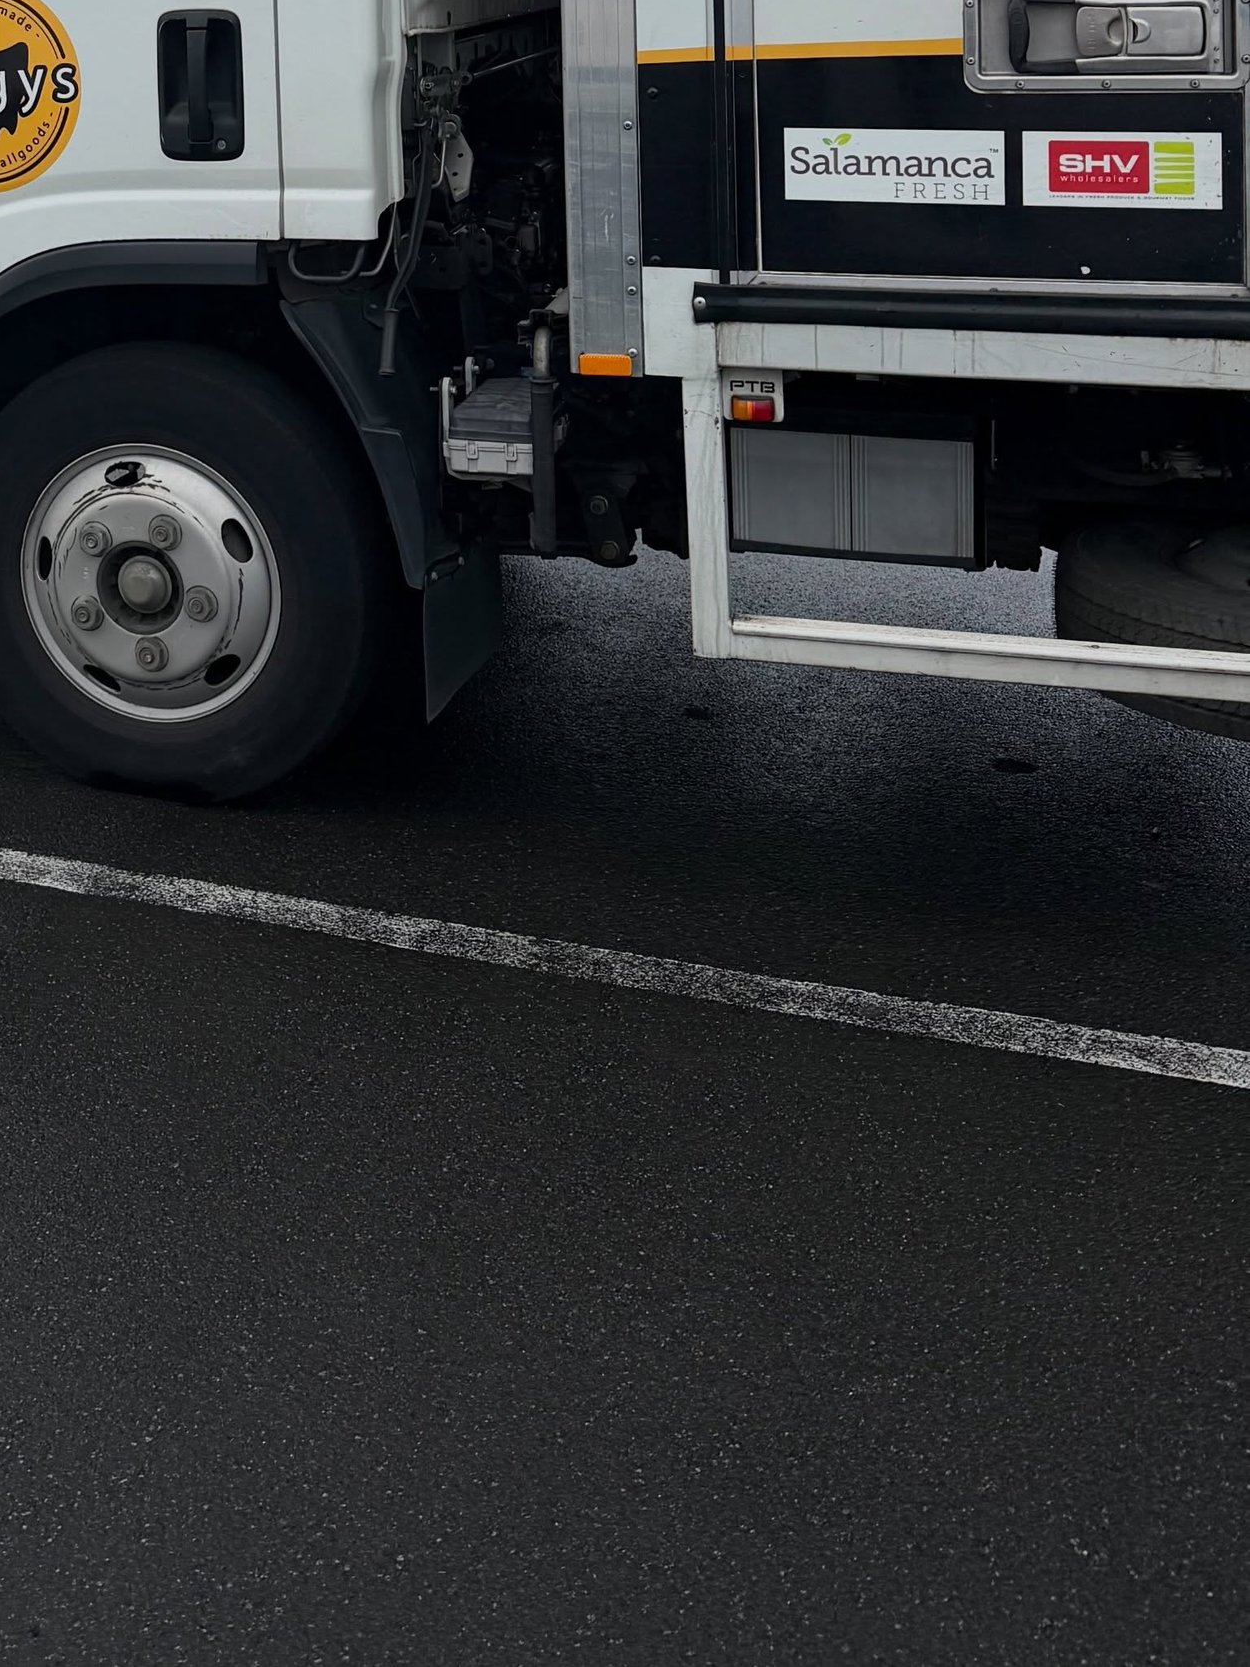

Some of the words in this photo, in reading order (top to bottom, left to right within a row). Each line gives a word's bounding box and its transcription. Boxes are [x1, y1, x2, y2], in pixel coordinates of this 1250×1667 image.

[789, 145, 995, 179] Salamanca
[1058, 154, 1140, 174] SHV
[1059, 174, 1139, 183] wholesalers
[893, 182, 990, 200] FRESH
[730, 380, 775, 393] PTB
